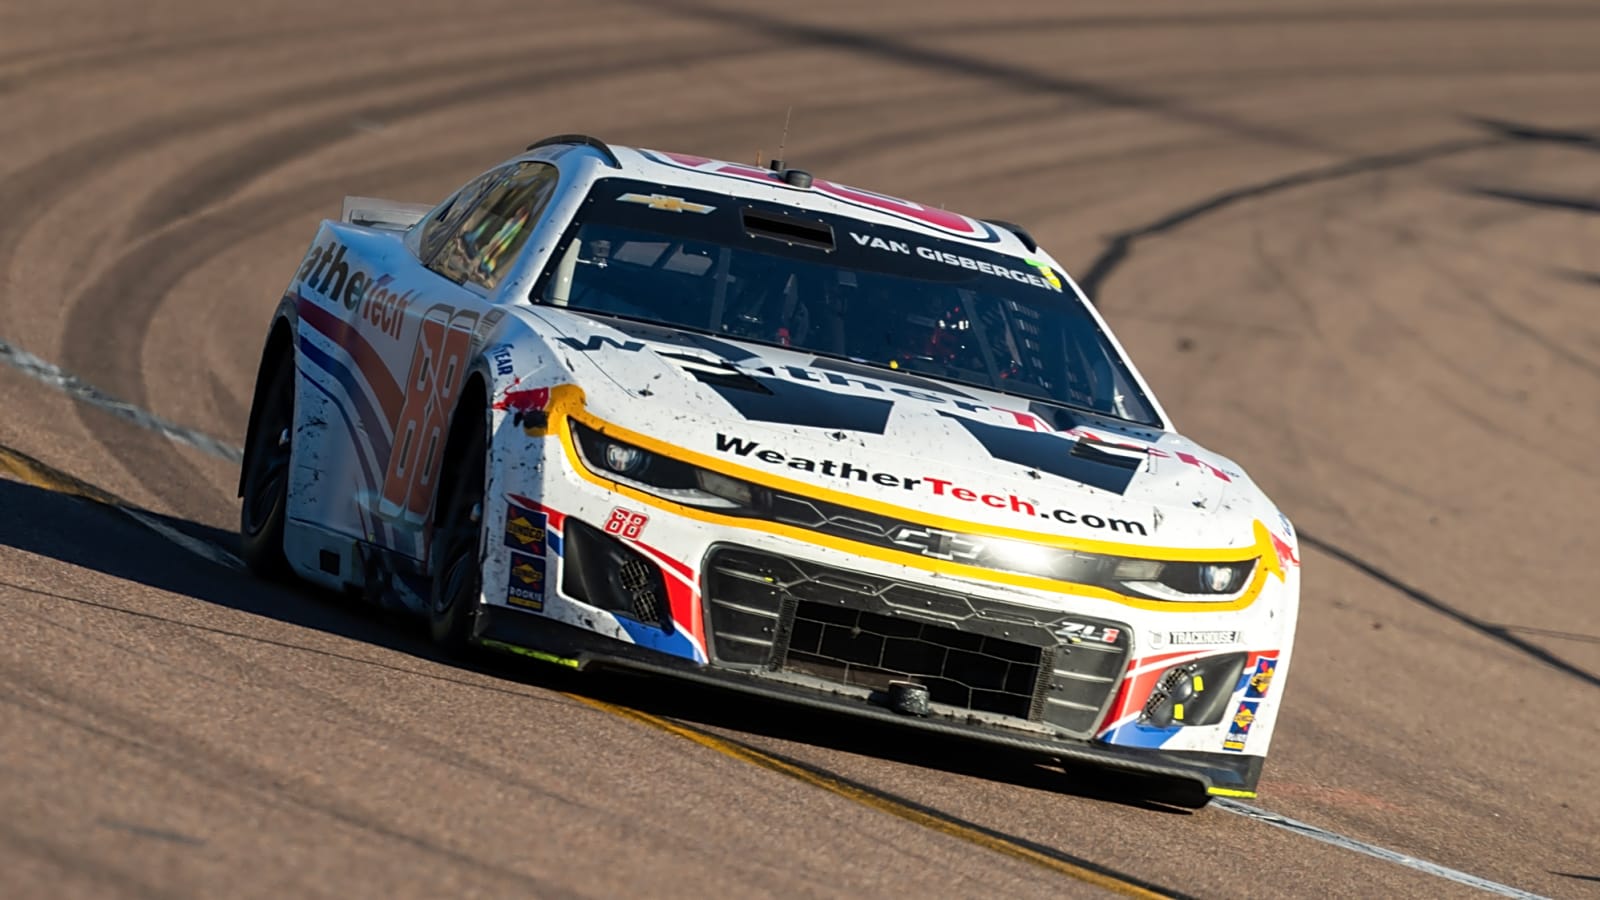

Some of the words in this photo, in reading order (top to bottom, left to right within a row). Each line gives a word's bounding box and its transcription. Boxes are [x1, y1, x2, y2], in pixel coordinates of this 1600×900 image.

[849, 232, 910, 254] VAN
[379, 303, 480, 520] 88
[715, 432, 1148, 537] WeatherTech.com
[604, 508, 649, 540] 88
[1055, 621, 1120, 643] ZL1
